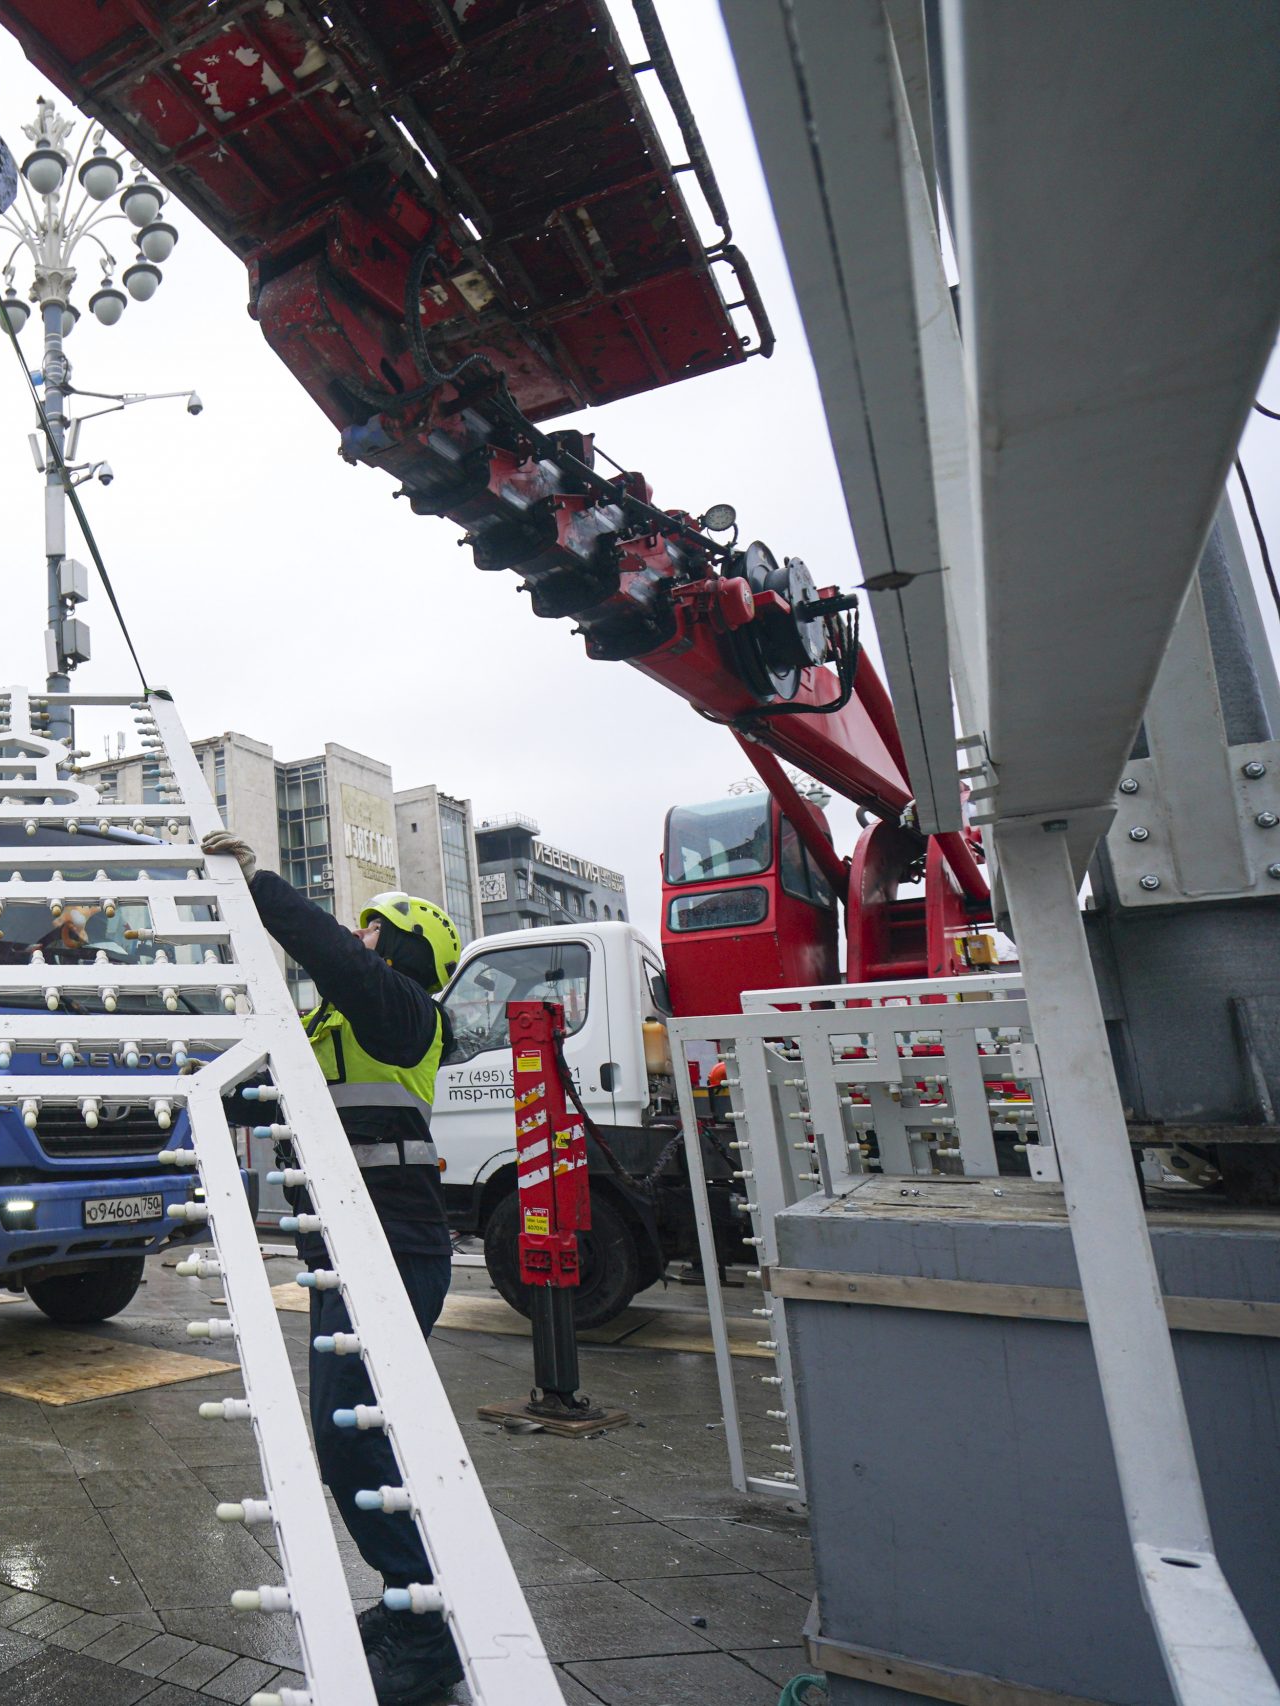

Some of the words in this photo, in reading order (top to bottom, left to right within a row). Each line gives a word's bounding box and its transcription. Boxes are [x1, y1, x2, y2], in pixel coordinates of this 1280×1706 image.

[343, 823, 396, 870] ИЗВЕСТИЯ
[534, 842, 599, 883] ИЗВЕСТИЯ
[448, 1072, 464, 1083] +7
[469, 1070, 505, 1085] (495)
[449, 1086, 515, 1102] msp-mo
[142, 1197, 159, 1210] 750
